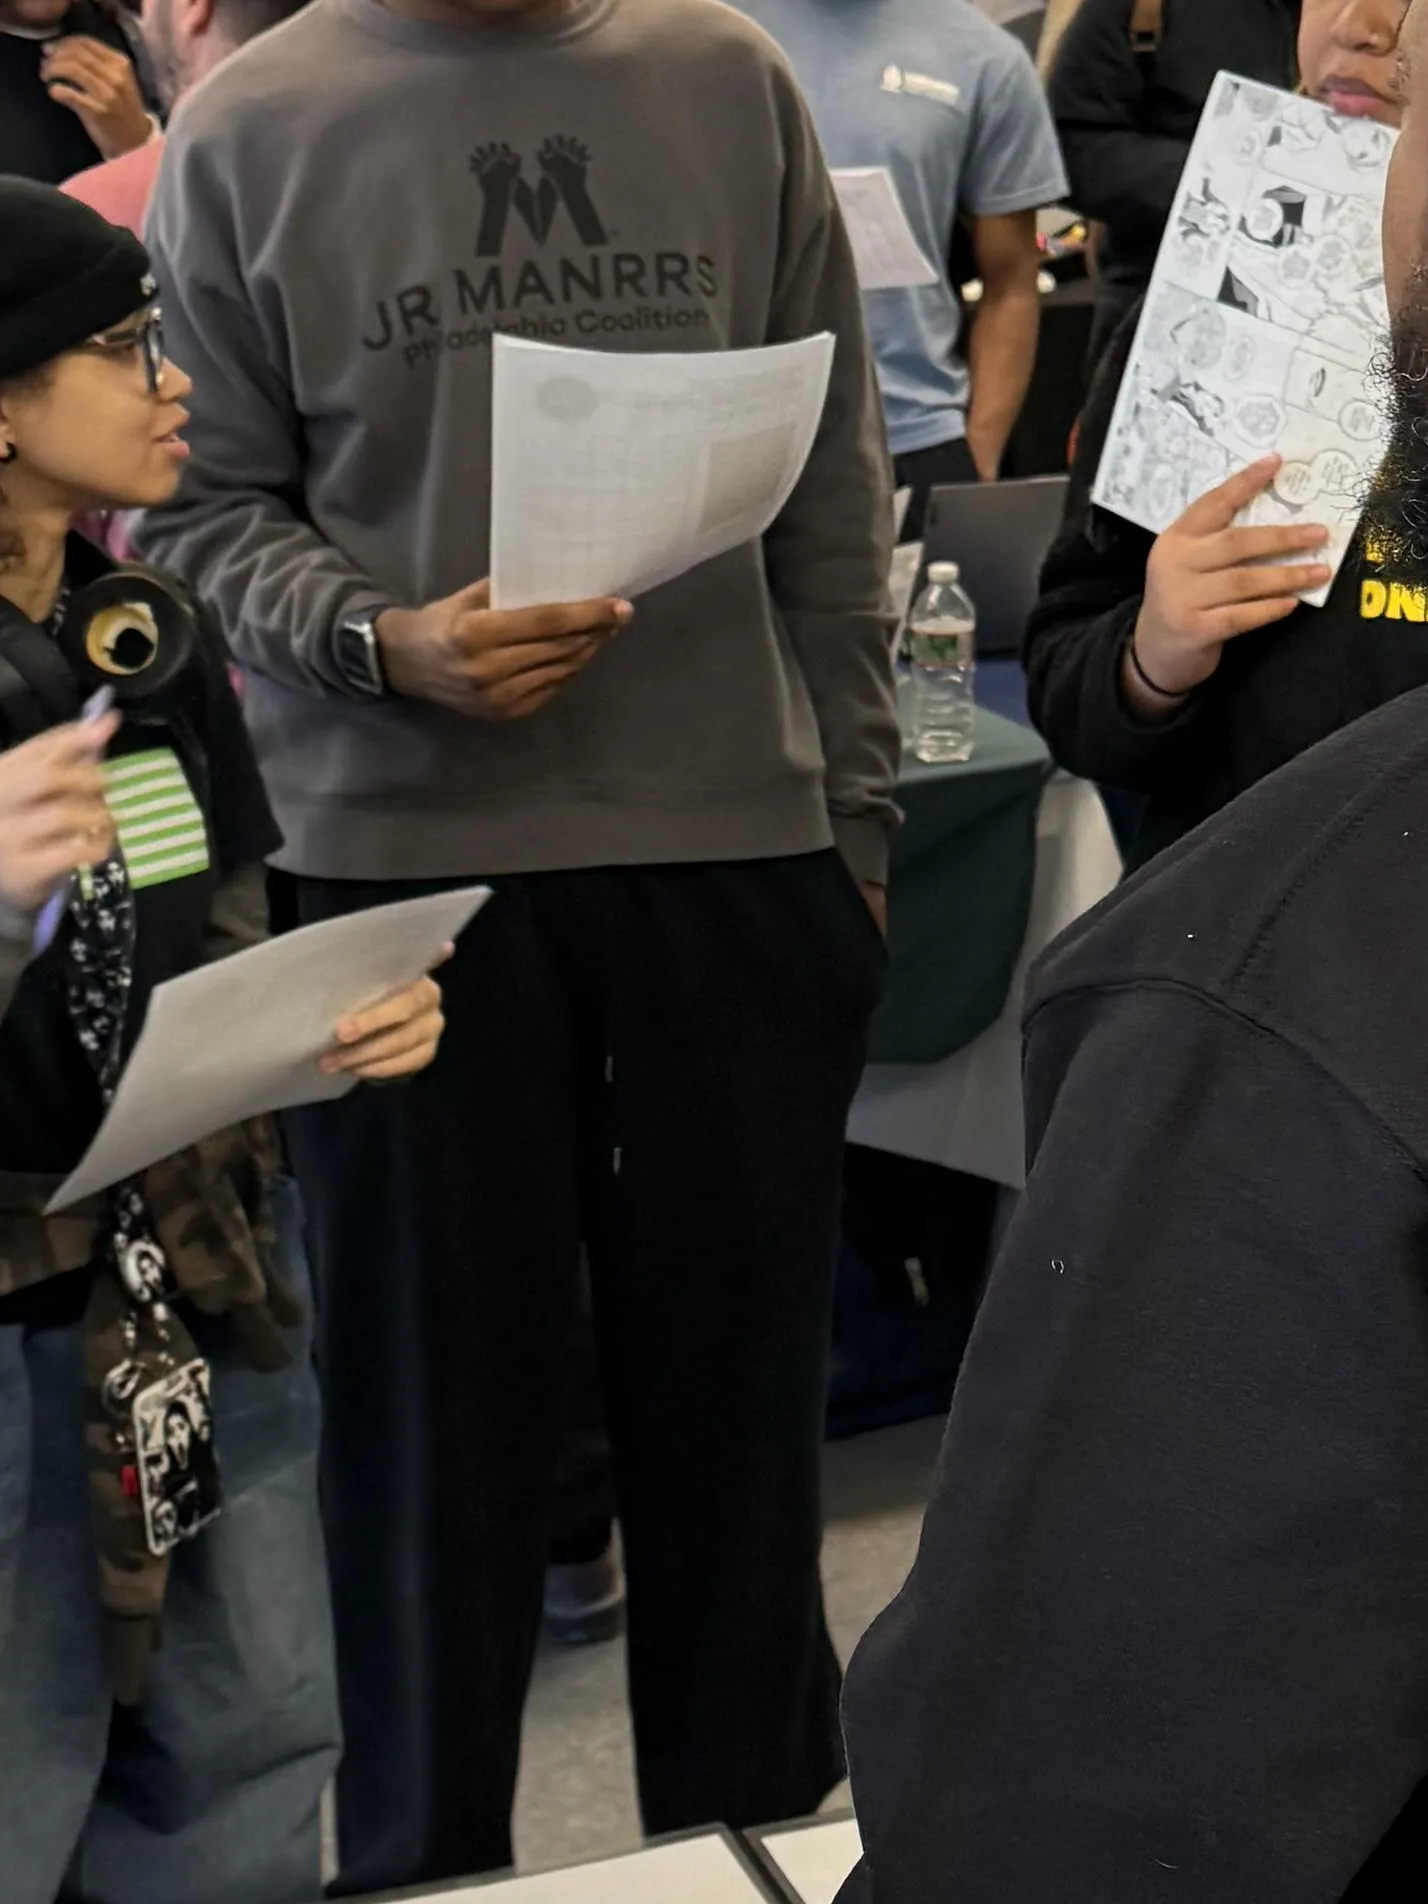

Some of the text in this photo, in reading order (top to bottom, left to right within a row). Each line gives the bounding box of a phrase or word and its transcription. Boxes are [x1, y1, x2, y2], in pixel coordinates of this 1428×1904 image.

[363, 251, 719, 352] JR MANRRS
[575, 305, 711, 336] Coalition
